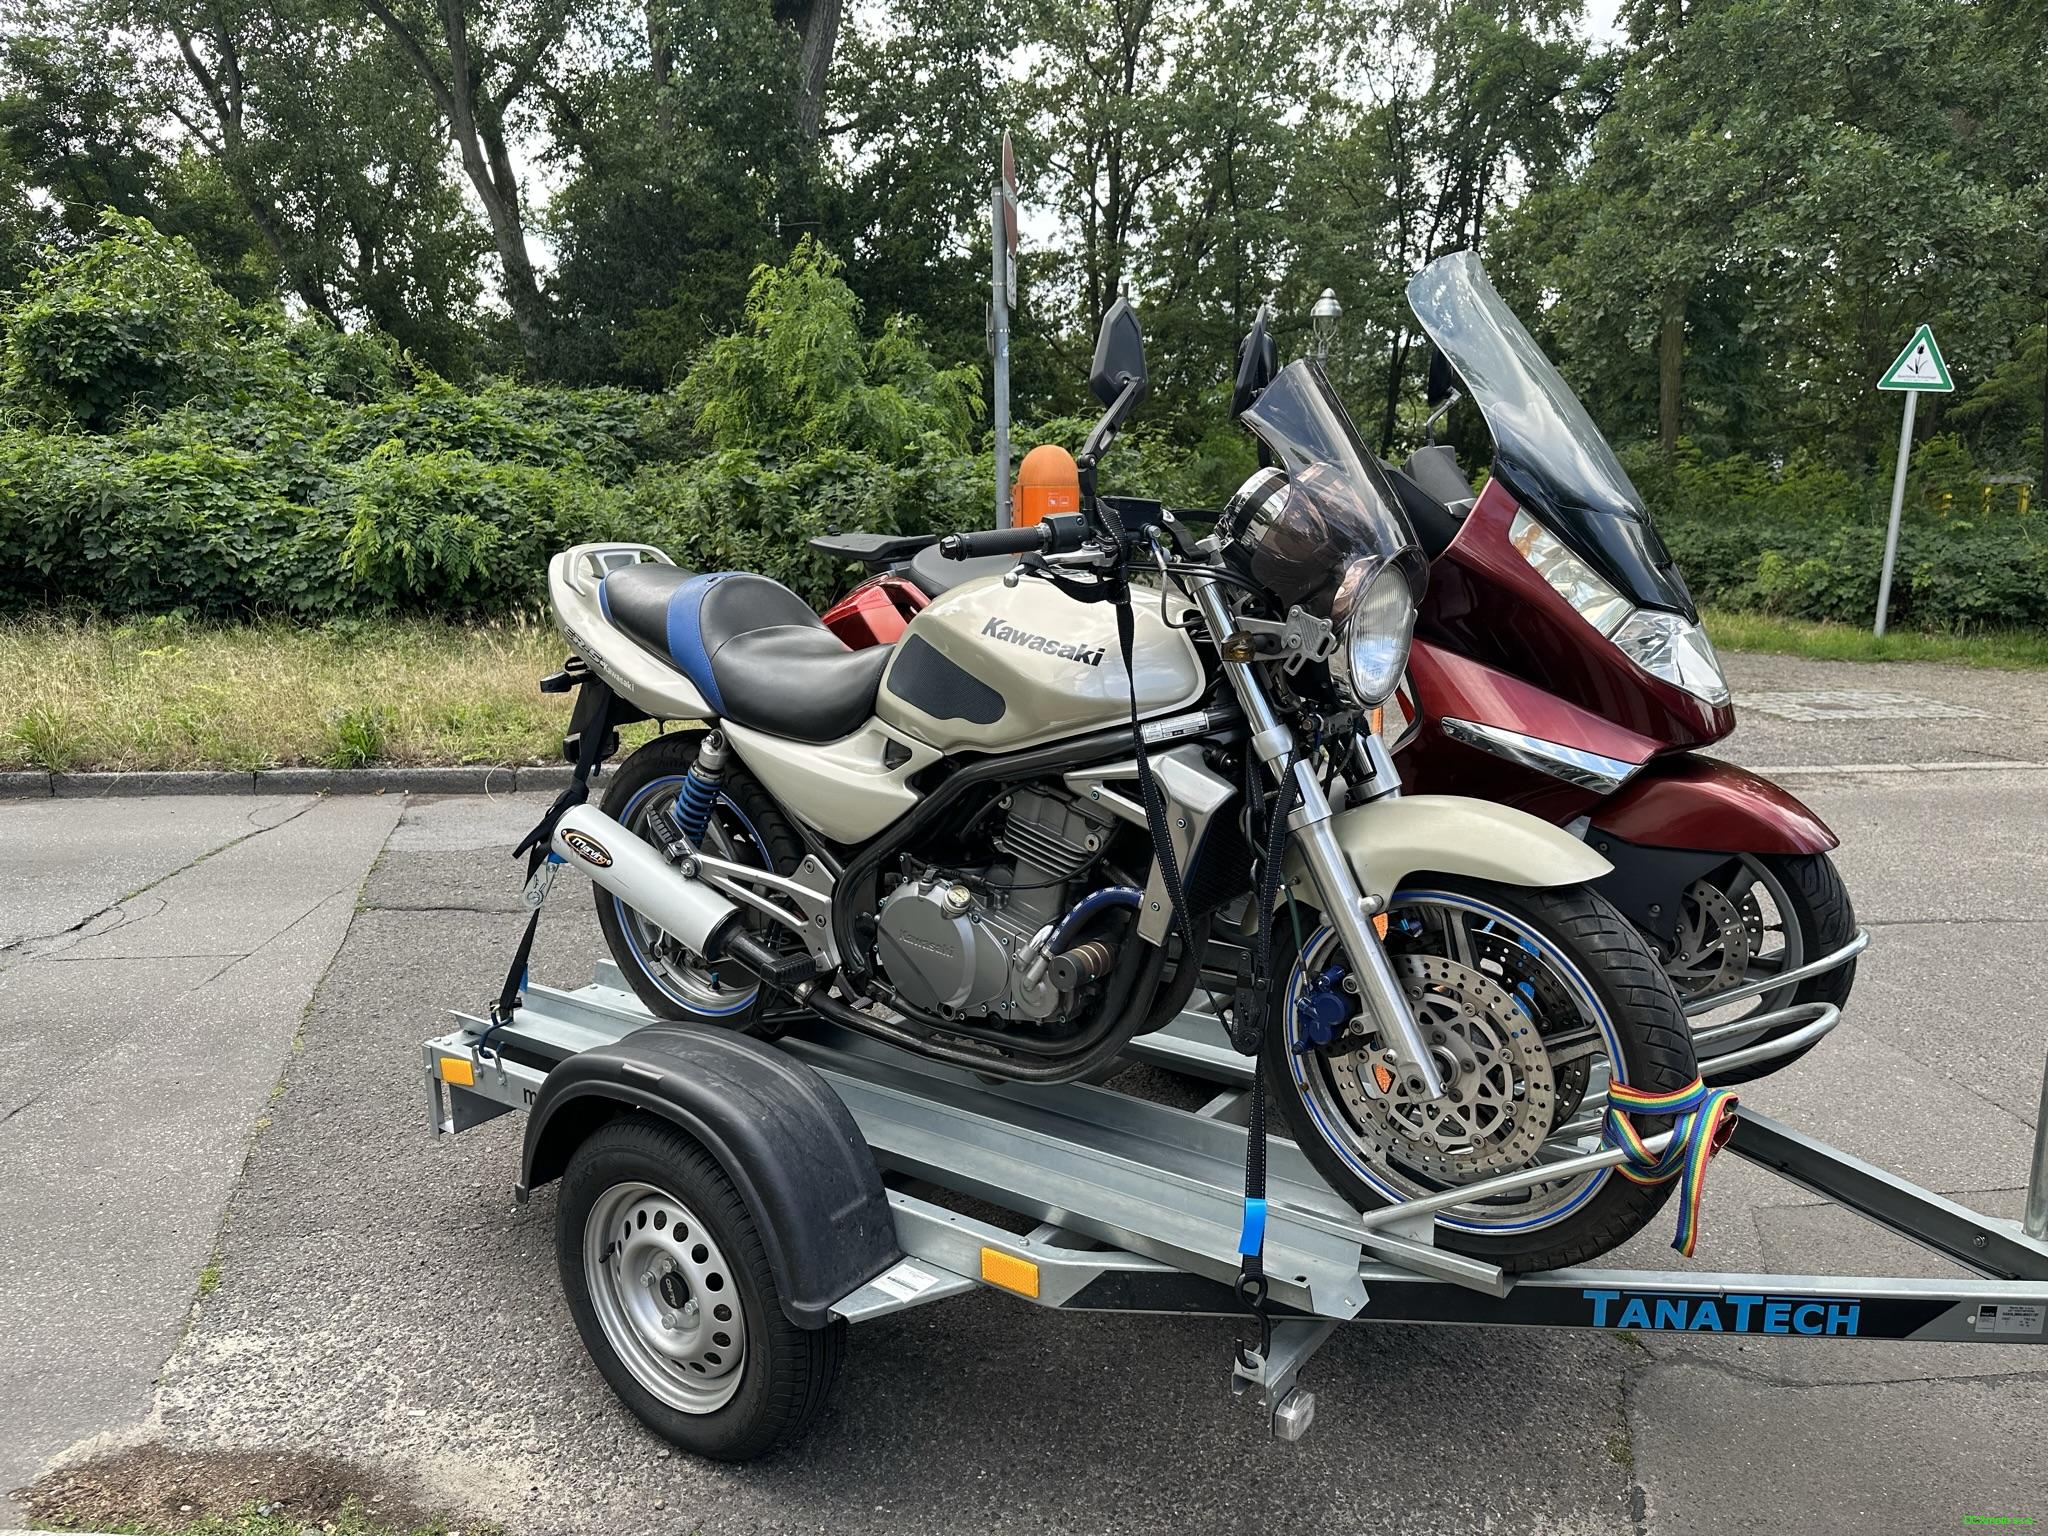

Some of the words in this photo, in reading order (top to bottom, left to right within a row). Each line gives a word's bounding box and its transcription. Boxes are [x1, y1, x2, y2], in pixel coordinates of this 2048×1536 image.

[564, 624, 603, 664] ER-5
[981, 616, 1106, 667] Kawasaki
[602, 661, 635, 692] Kawasaki
